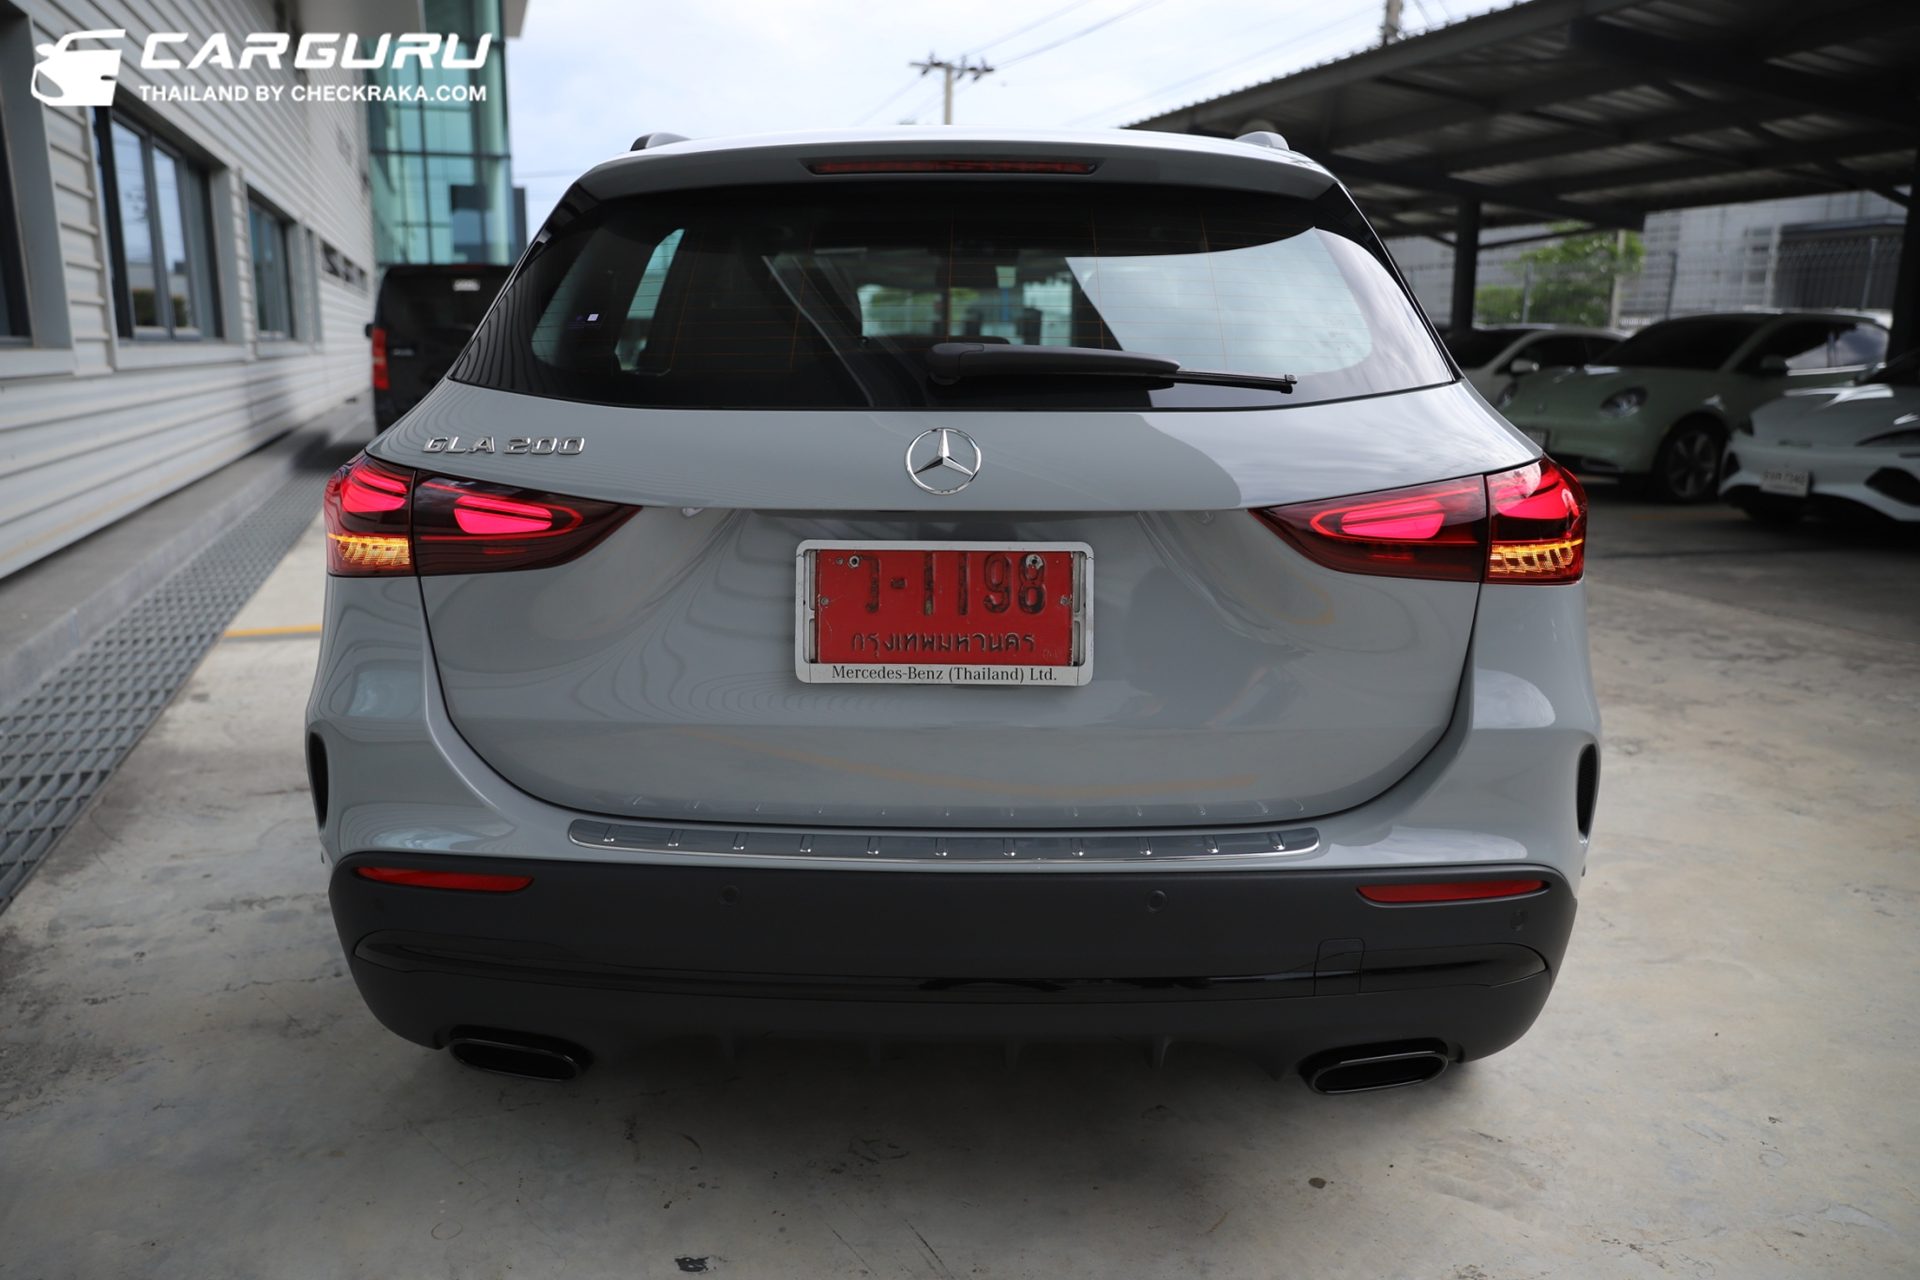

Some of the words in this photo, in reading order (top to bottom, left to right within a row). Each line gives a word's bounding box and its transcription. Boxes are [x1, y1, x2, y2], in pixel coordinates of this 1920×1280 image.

[422, 436, 496, 454] GLA
[504, 437, 585, 455] 200
[851, 631, 1036, 658] กรุงเทพมหานคร
[832, 665, 944, 681] Mercedes-Benz
[948, 667, 1024, 684] (Thailand)
[1030, 668, 1057, 681] Ltd.
